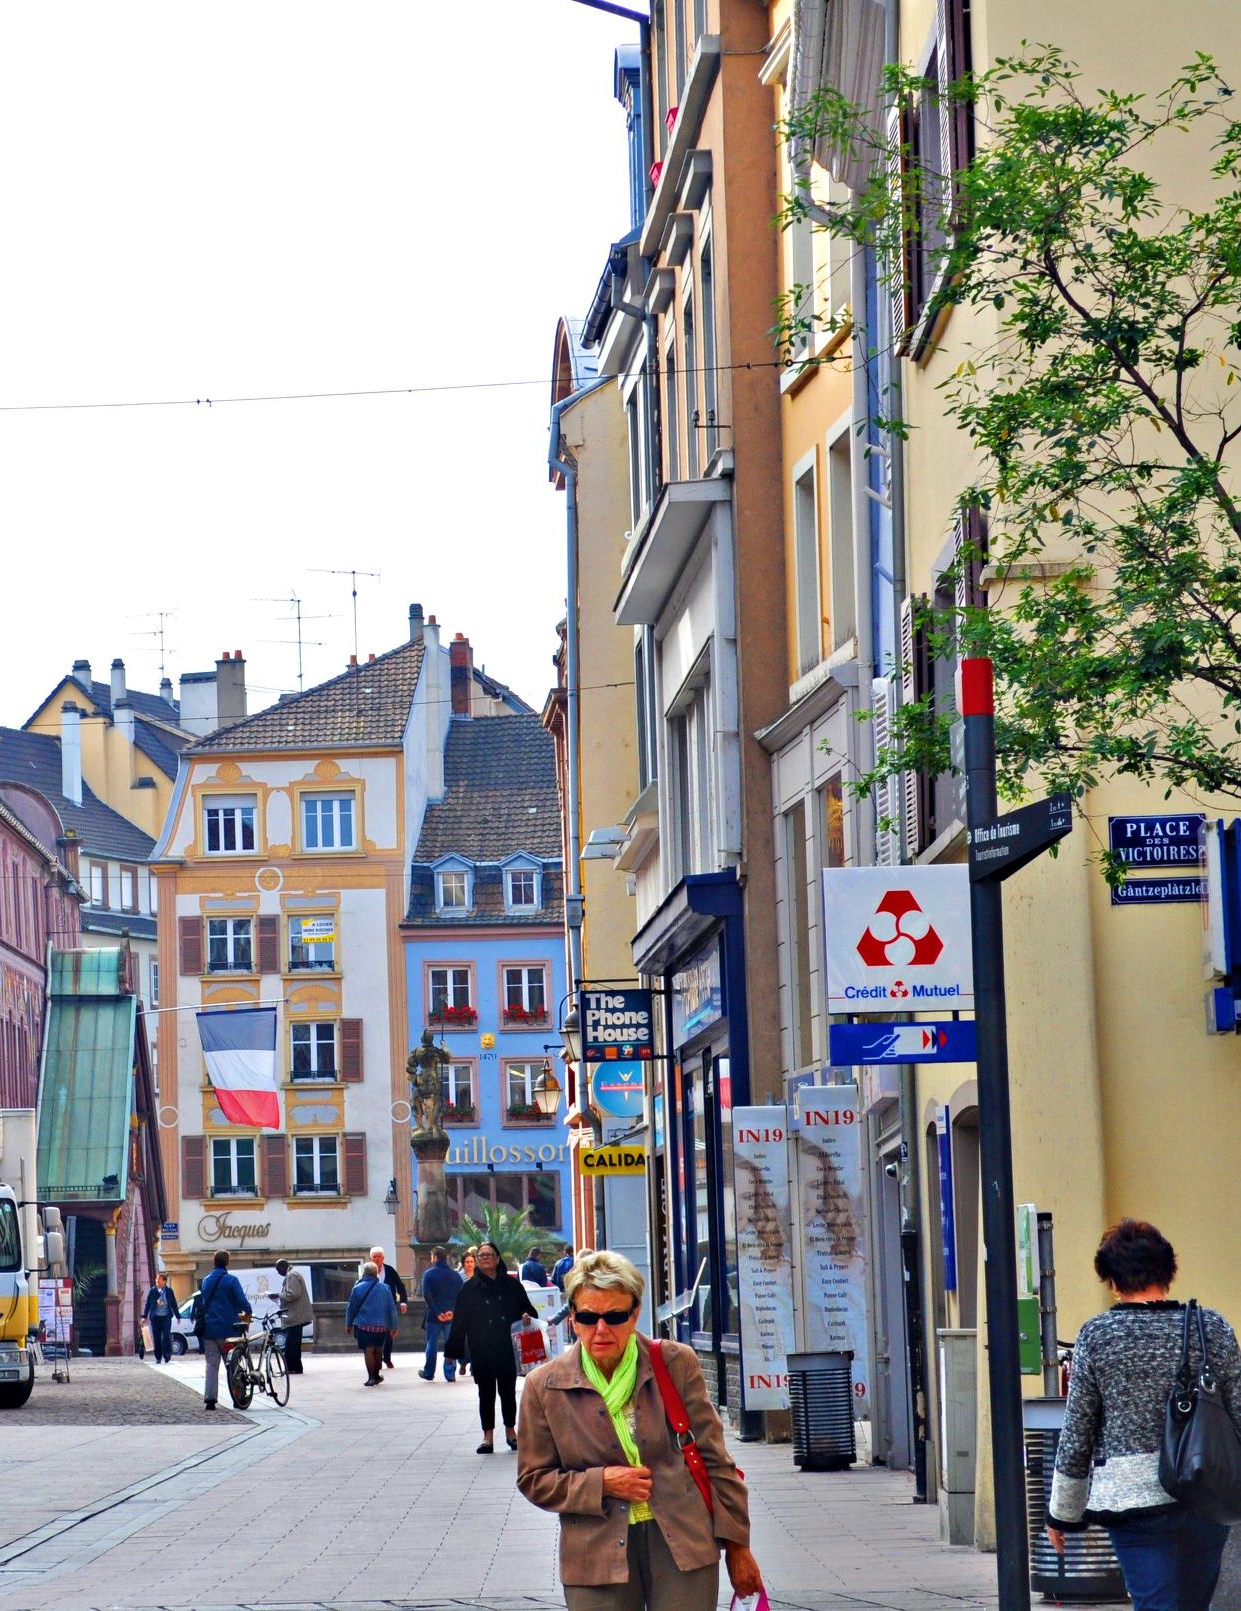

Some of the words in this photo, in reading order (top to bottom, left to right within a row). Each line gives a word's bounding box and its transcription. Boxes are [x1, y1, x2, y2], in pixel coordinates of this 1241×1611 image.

[974, 828, 990, 843] Office
[990, 826, 997, 840] de
[997, 822, 1020, 840] Tourisme
[1126, 821, 1190, 837] PLACE
[1119, 846, 1197, 861] VICTOIRES
[844, 986, 887, 999] Crédit
[912, 984, 960, 997] Mutuel
[585, 993, 625, 1009] The
[586, 1010, 649, 1026] Phone
[587, 1026, 650, 1042] House
[805, 1110, 855, 1126] IN19
[738, 1129, 783, 1143] IN19
[583, 1153, 646, 1168] CALIDA
[198, 1212, 271, 1248] Jacques
